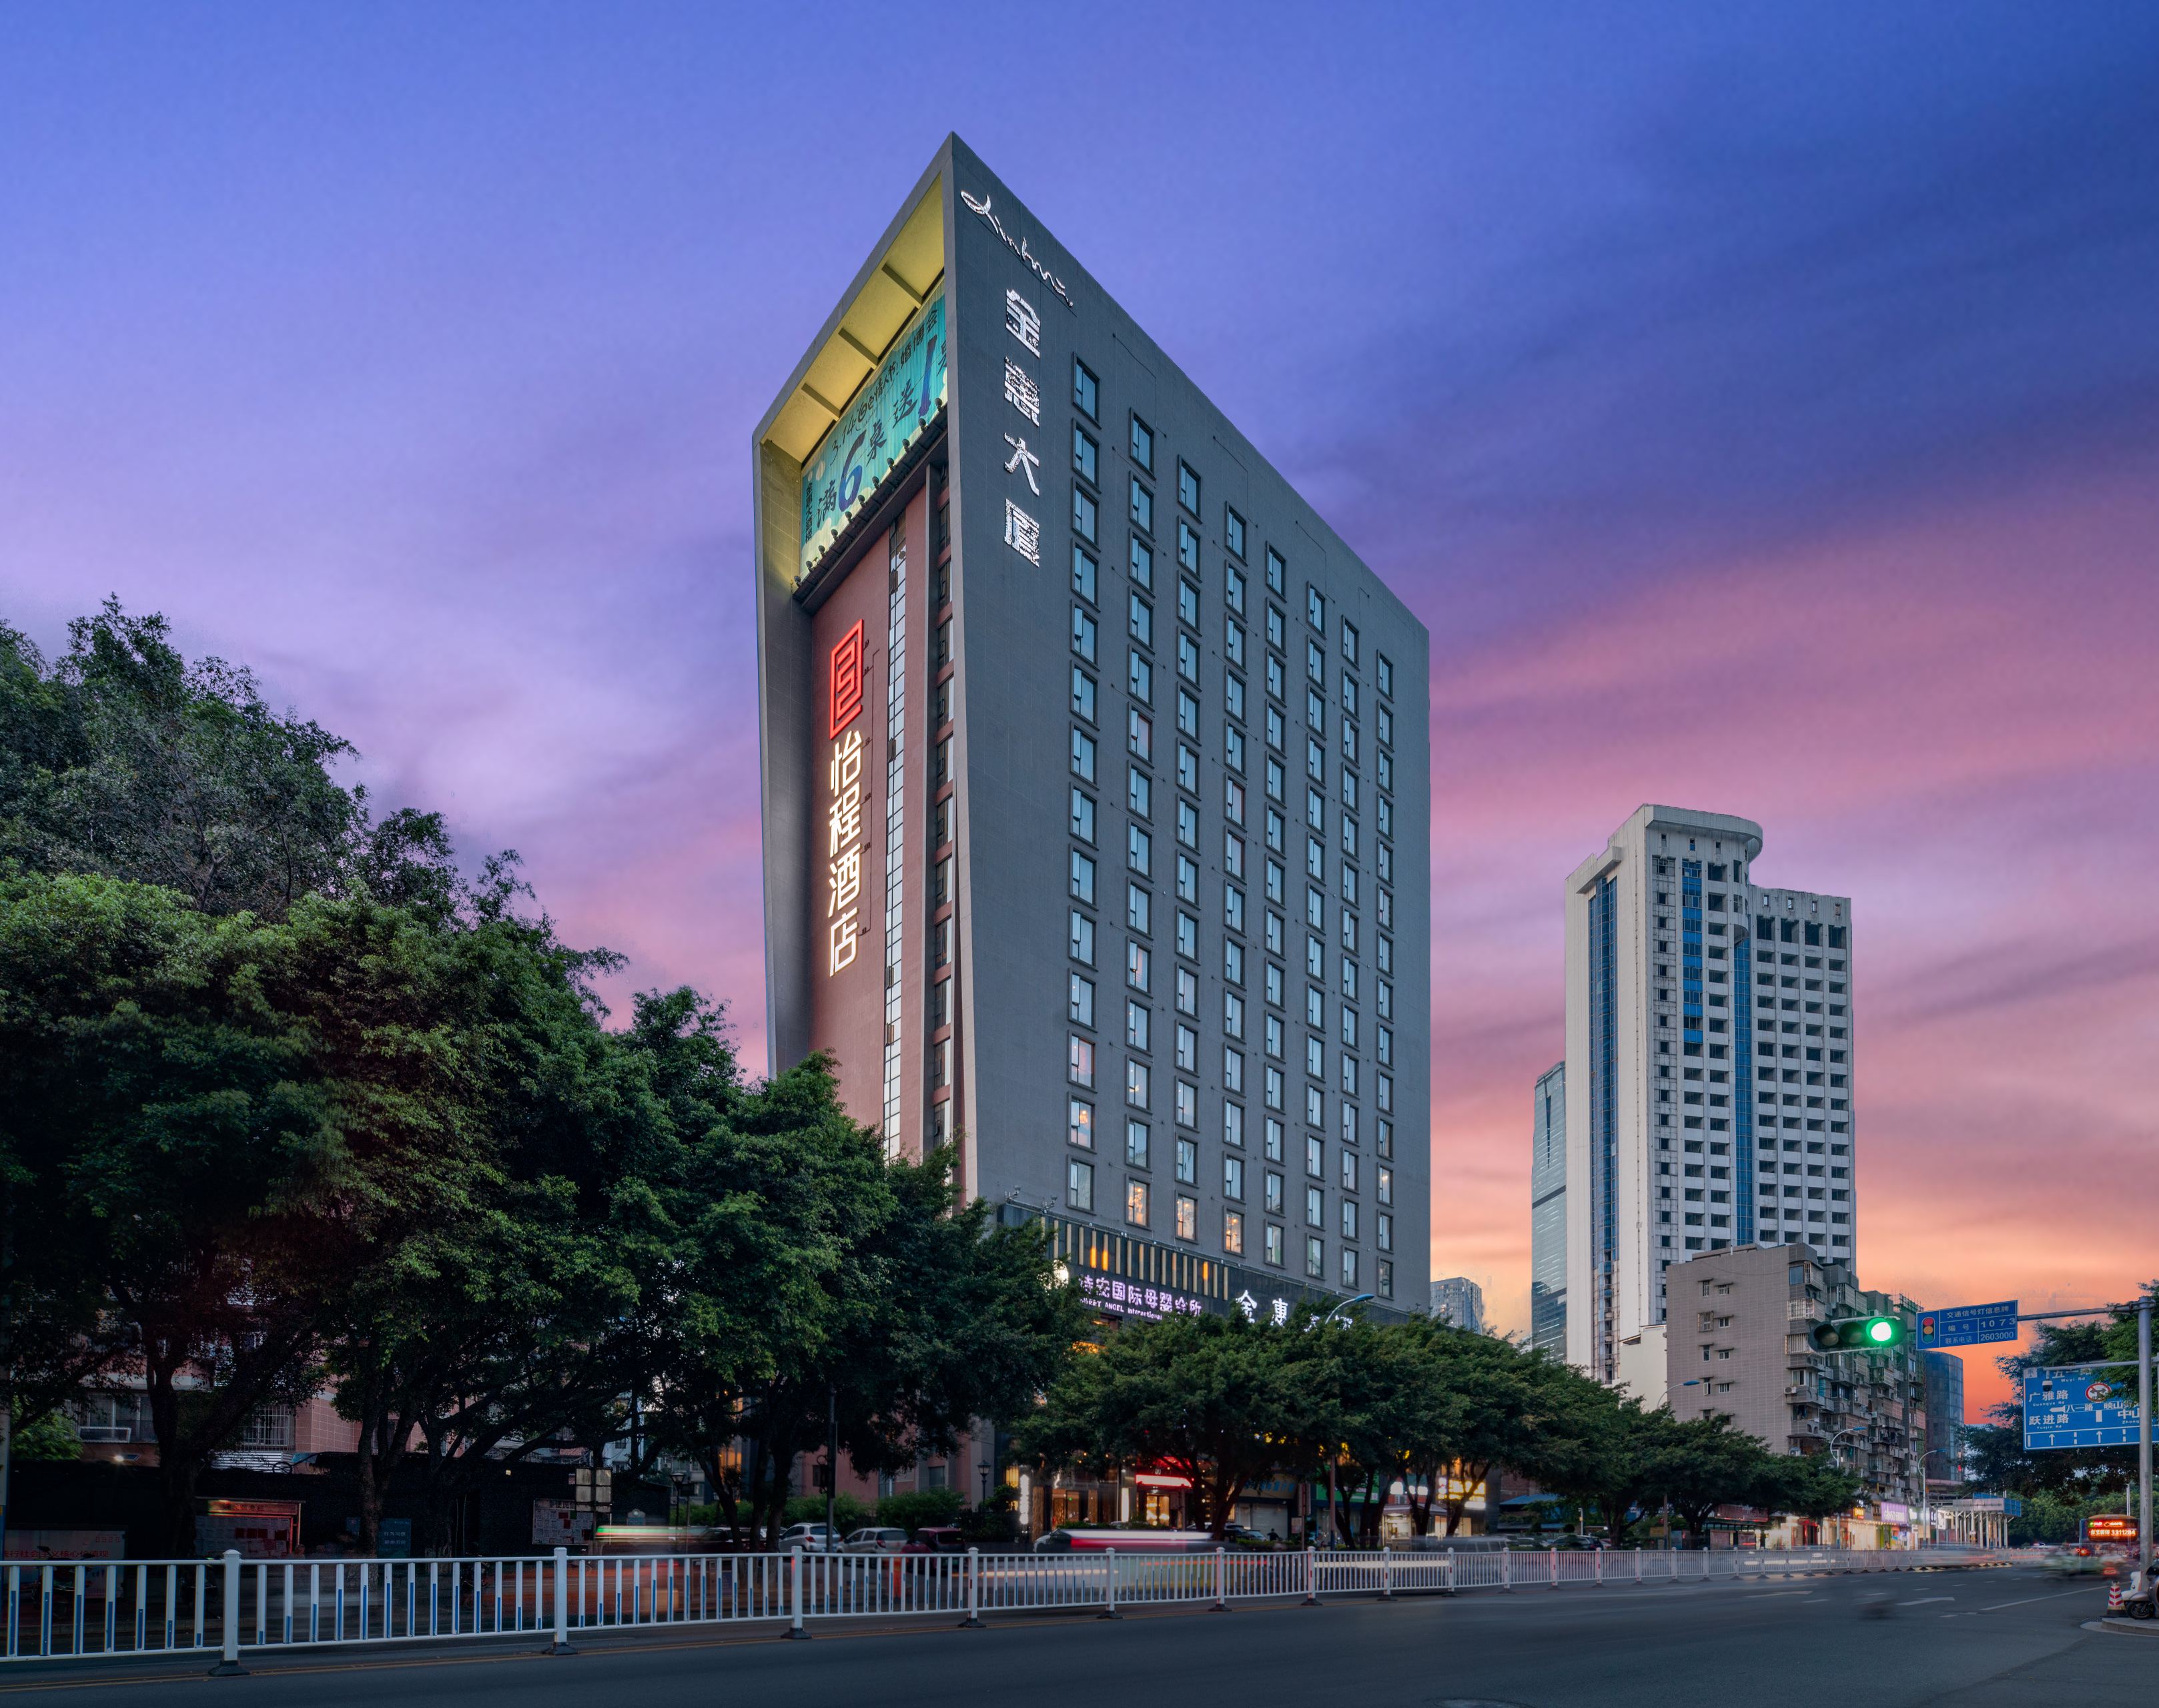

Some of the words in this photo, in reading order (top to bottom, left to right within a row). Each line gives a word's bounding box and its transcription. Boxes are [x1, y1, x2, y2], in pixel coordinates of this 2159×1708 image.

[828, 730, 861, 977] 怡程酒店
[1105, 1302, 1124, 1312] ANGEL
[1946, 1306, 2010, 1318] 交通信号灯信息牌
[1948, 1324, 1970, 1332] 编号
[1945, 1336, 1973, 1344] 联系电话
[1980, 1332, 2014, 1342] 2603000
[2029, 1390, 2069, 1402] 广雅路
[2066, 1404, 2094, 1412] 八一路
[2029, 1414, 2069, 1425] 跃进路
